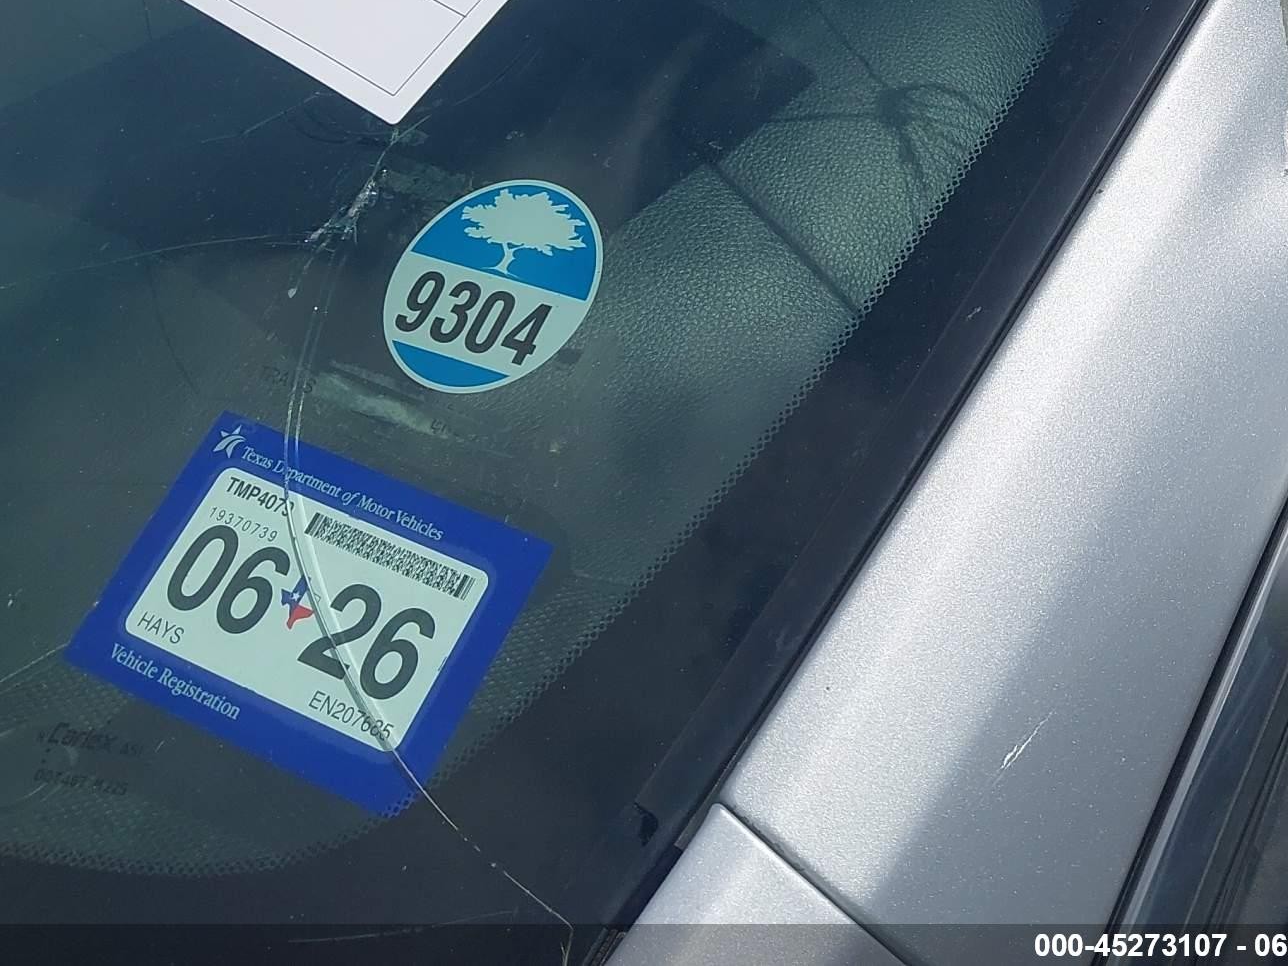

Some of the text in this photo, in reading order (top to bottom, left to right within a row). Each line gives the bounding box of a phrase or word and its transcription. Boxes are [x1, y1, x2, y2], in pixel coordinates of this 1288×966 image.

[395, 270, 555, 367] 9304
[209, 506, 278, 542] 19370739
[241, 445, 273, 470] Texas
[341, 489, 356, 507] of
[356, 494, 396, 520] Motor
[394, 508, 444, 541] Vehicles
[137, 610, 185, 645] HAYS
[167, 523, 436, 701] 06 26
[111, 642, 241, 721] Vehicle Registration
[308, 690, 394, 741] EN207685
